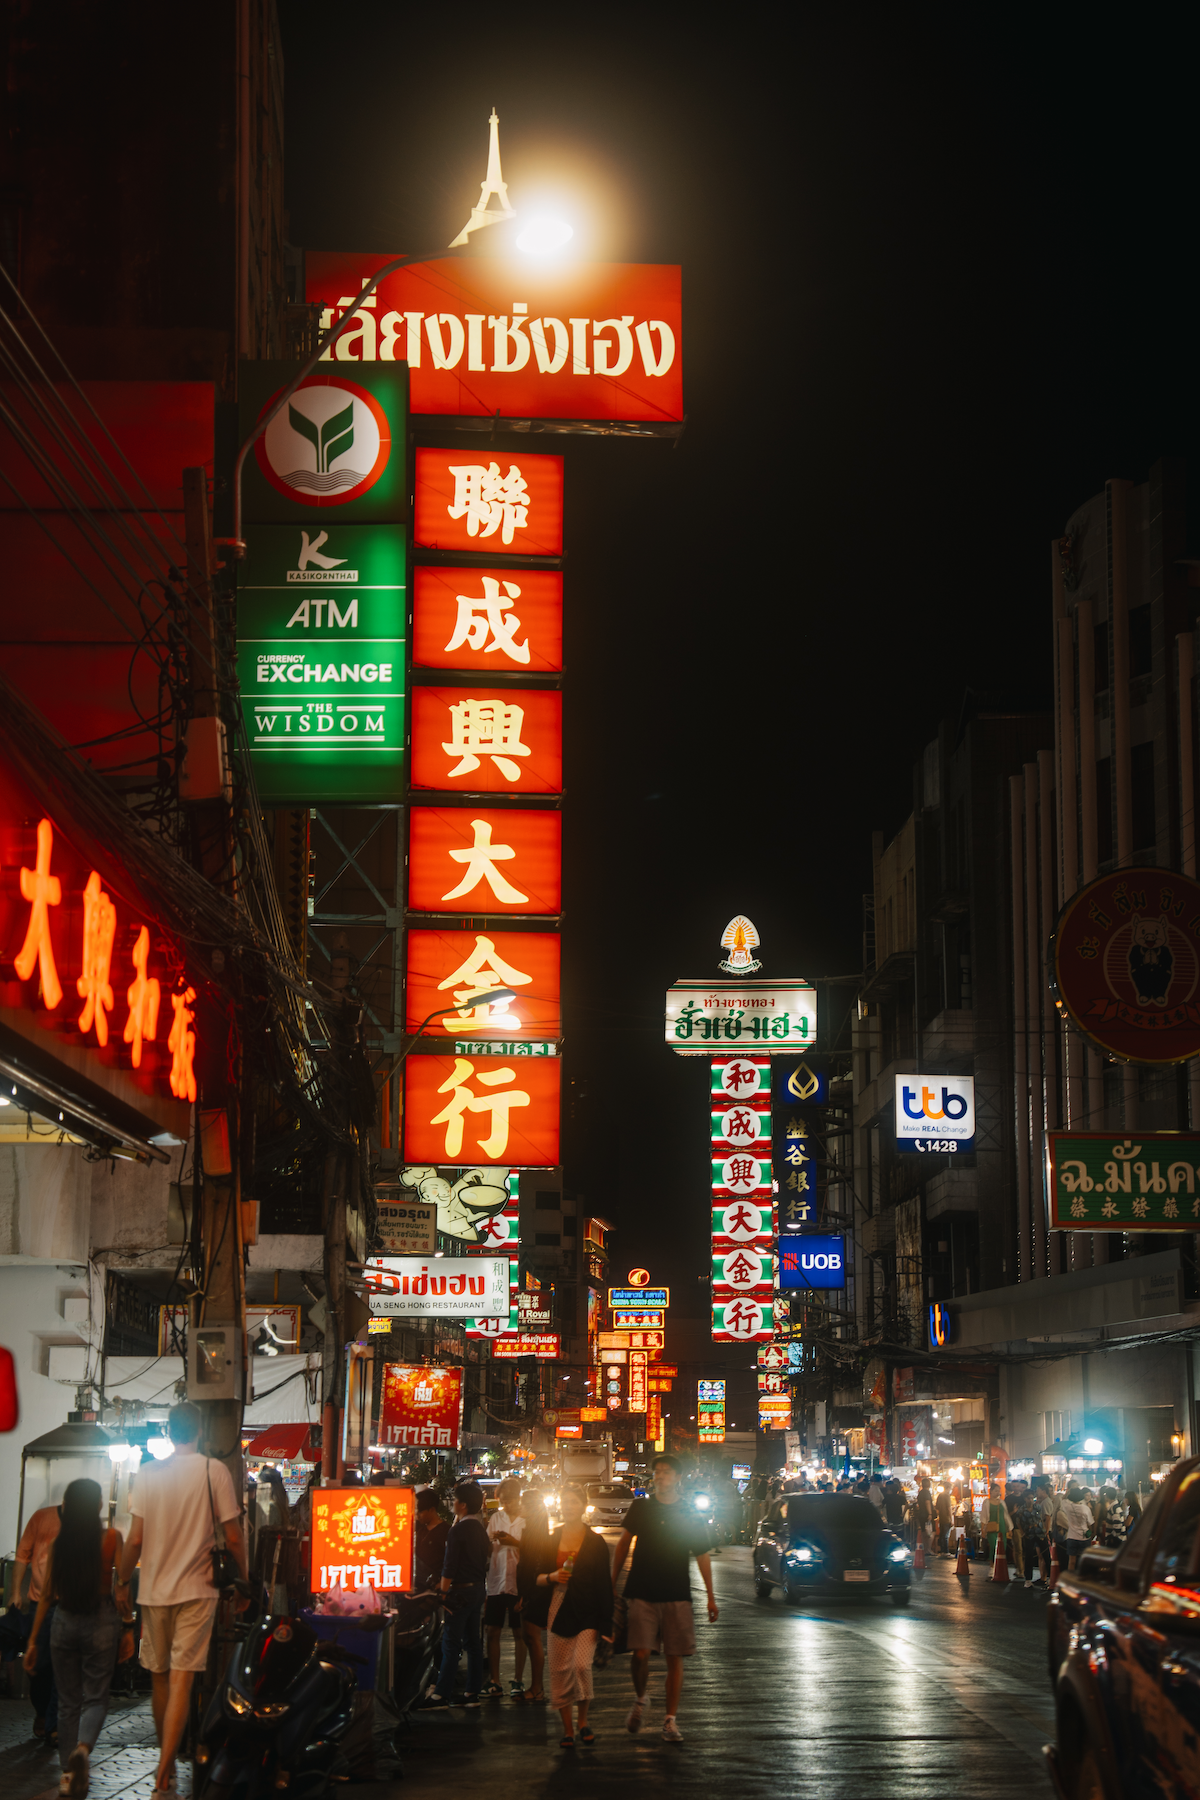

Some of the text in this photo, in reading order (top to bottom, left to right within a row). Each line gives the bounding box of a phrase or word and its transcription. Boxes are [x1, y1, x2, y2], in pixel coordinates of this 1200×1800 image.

[286, 599, 358, 628] ATM
[257, 655, 305, 663] CURRENCY
[257, 664, 392, 683] EXCHANGE
[307, 703, 333, 713] THE
[255, 714, 385, 732] WISDOM
[703, 994, 775, 1008] ห้างขายทอง
[675, 1000, 809, 1040] ฮั่วเซ่งเฮง
[903, 1086, 968, 1120] ttb
[942, 1126, 967, 1134] Change
[926, 1140, 958, 1152] 1428
[1060, 1140, 1200, 1194] ฉ.มั่นค
[725, 1062, 759, 1335] 和成興大金行
[802, 1254, 841, 1269] UOB
[526, 1310, 551, 1318] Royal
[929, 1303, 950, 1346] ttb
[387, 1420, 451, 1445] เกาลัด
[320, 1556, 402, 1589] เกาลัด
